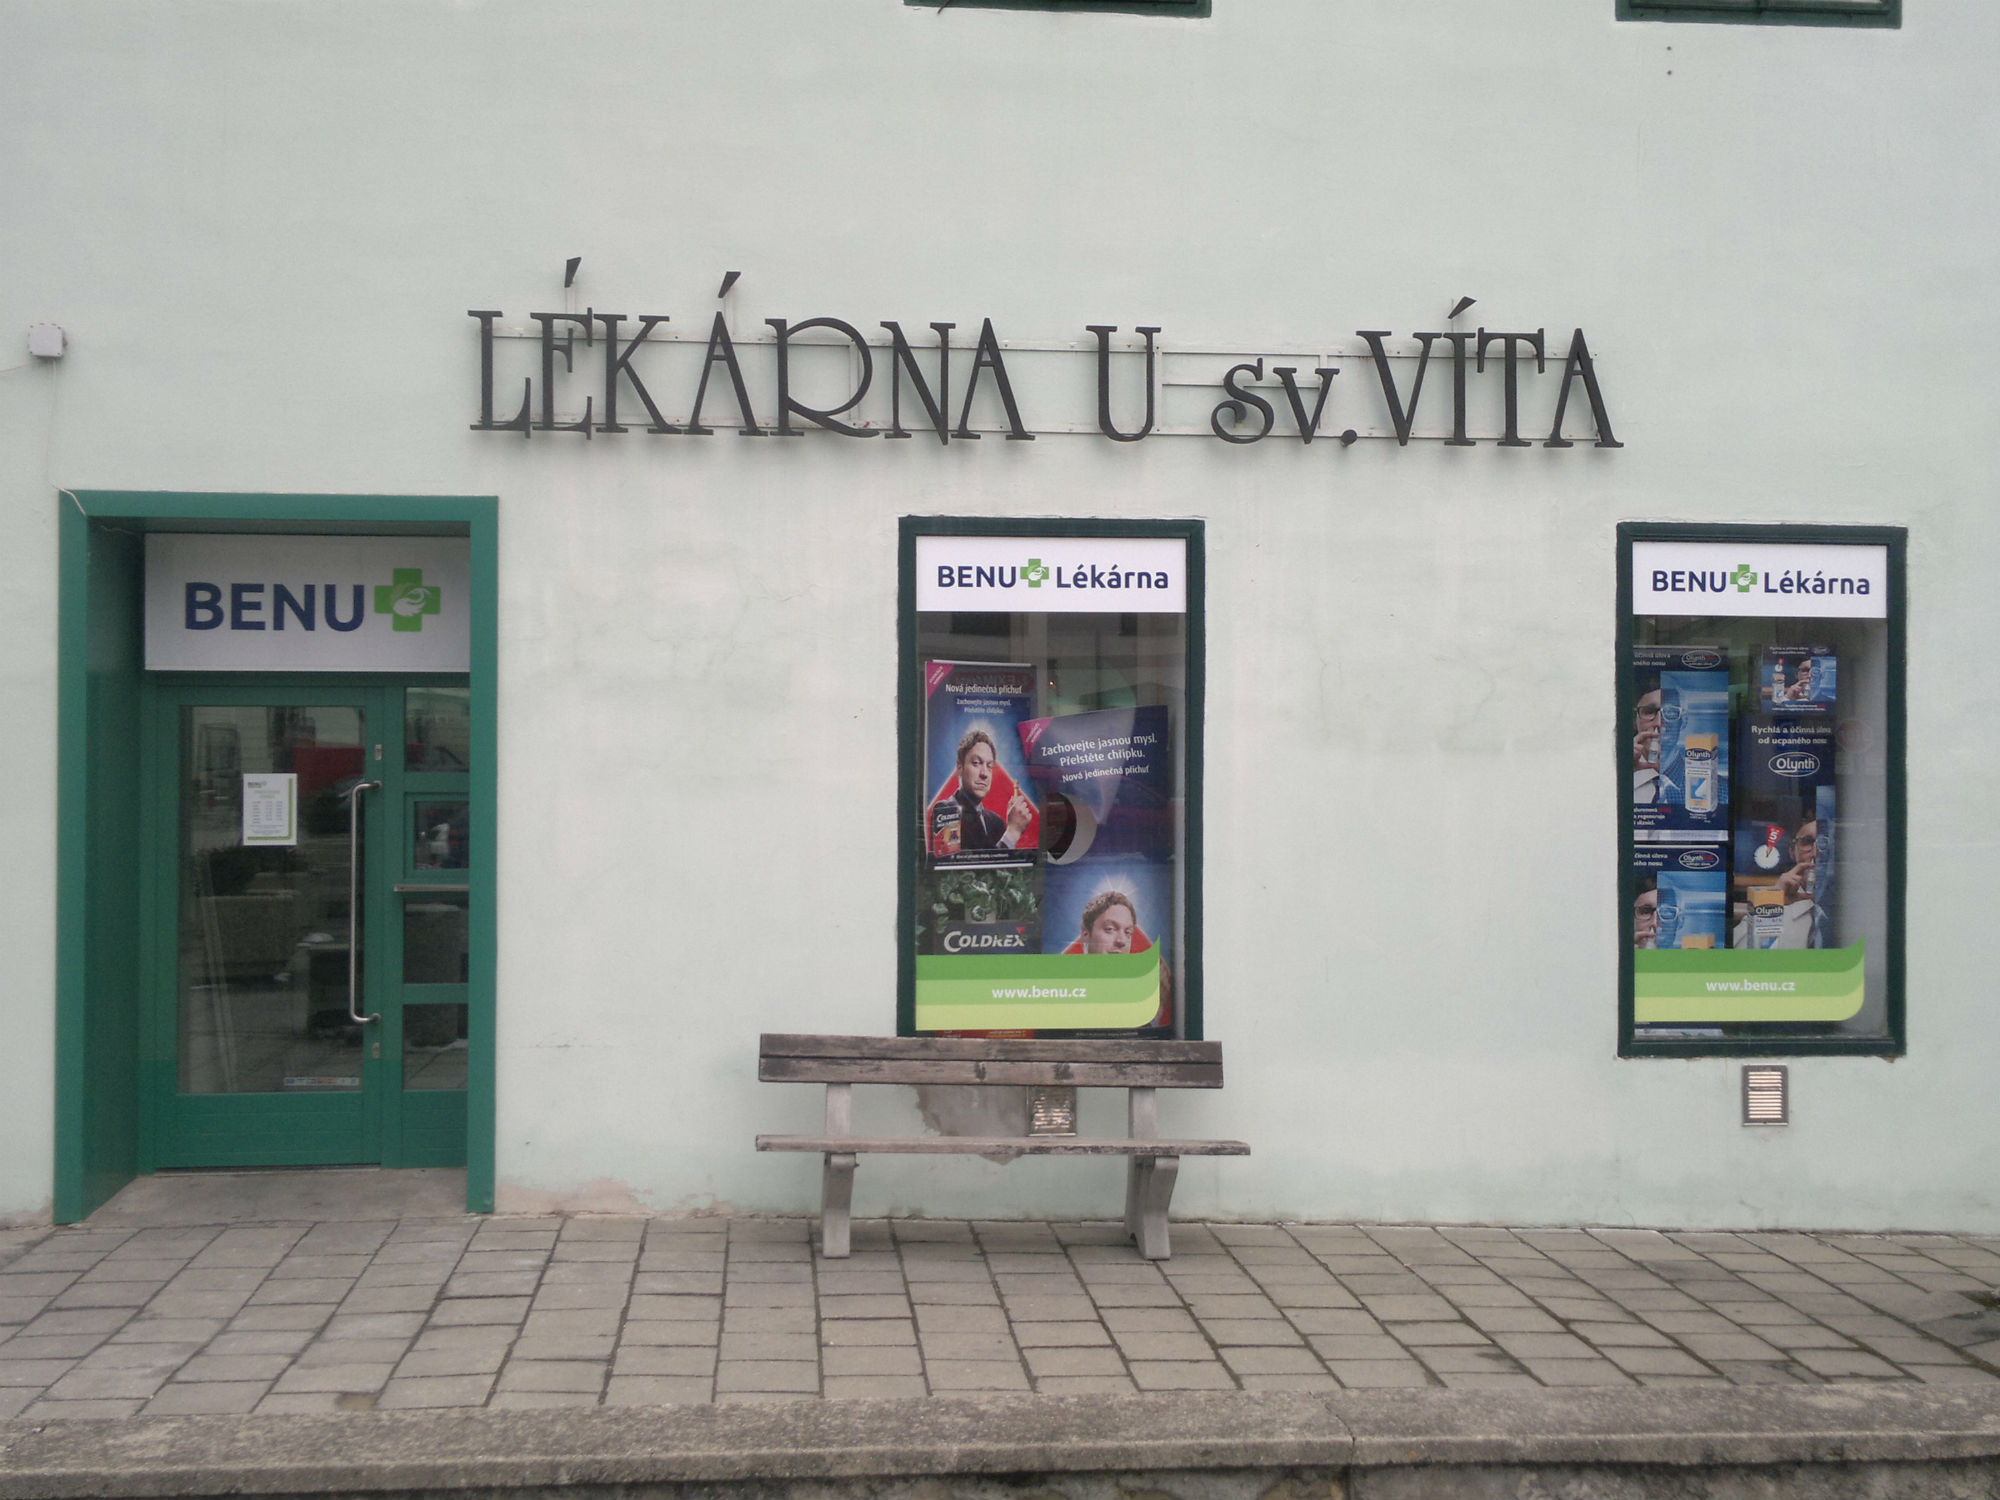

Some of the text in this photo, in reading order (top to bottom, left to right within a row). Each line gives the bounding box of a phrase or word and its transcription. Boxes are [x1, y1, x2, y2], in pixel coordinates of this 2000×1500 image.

[467, 256, 1036, 446] LÉKÁRNA
[1085, 324, 1162, 443] U
[1356, 296, 1625, 449] VÍTA
[937, 563, 1169, 589] BENU Lékárna
[1651, 569, 1871, 595] BENU Lékárna
[184, 581, 366, 632] BENU
[945, 683, 964, 693] Nová
[1751, 725, 1781, 735] Rychlá
[1040, 732, 1158, 757] Zachovejte jasnou mysl.
[1757, 736, 1770, 745] od
[1059, 748, 1146, 767] Přelstěte chřipku.
[1776, 757, 1815, 773] Olynth
[1061, 764, 1151, 784] Nová jedinečná příchuť
[1755, 906, 1783, 916] Olynth
[943, 930, 1026, 953] COLDREX
[991, 985, 1087, 998] www.benu.cz
[1705, 979, 1796, 992] www.benu.cz
